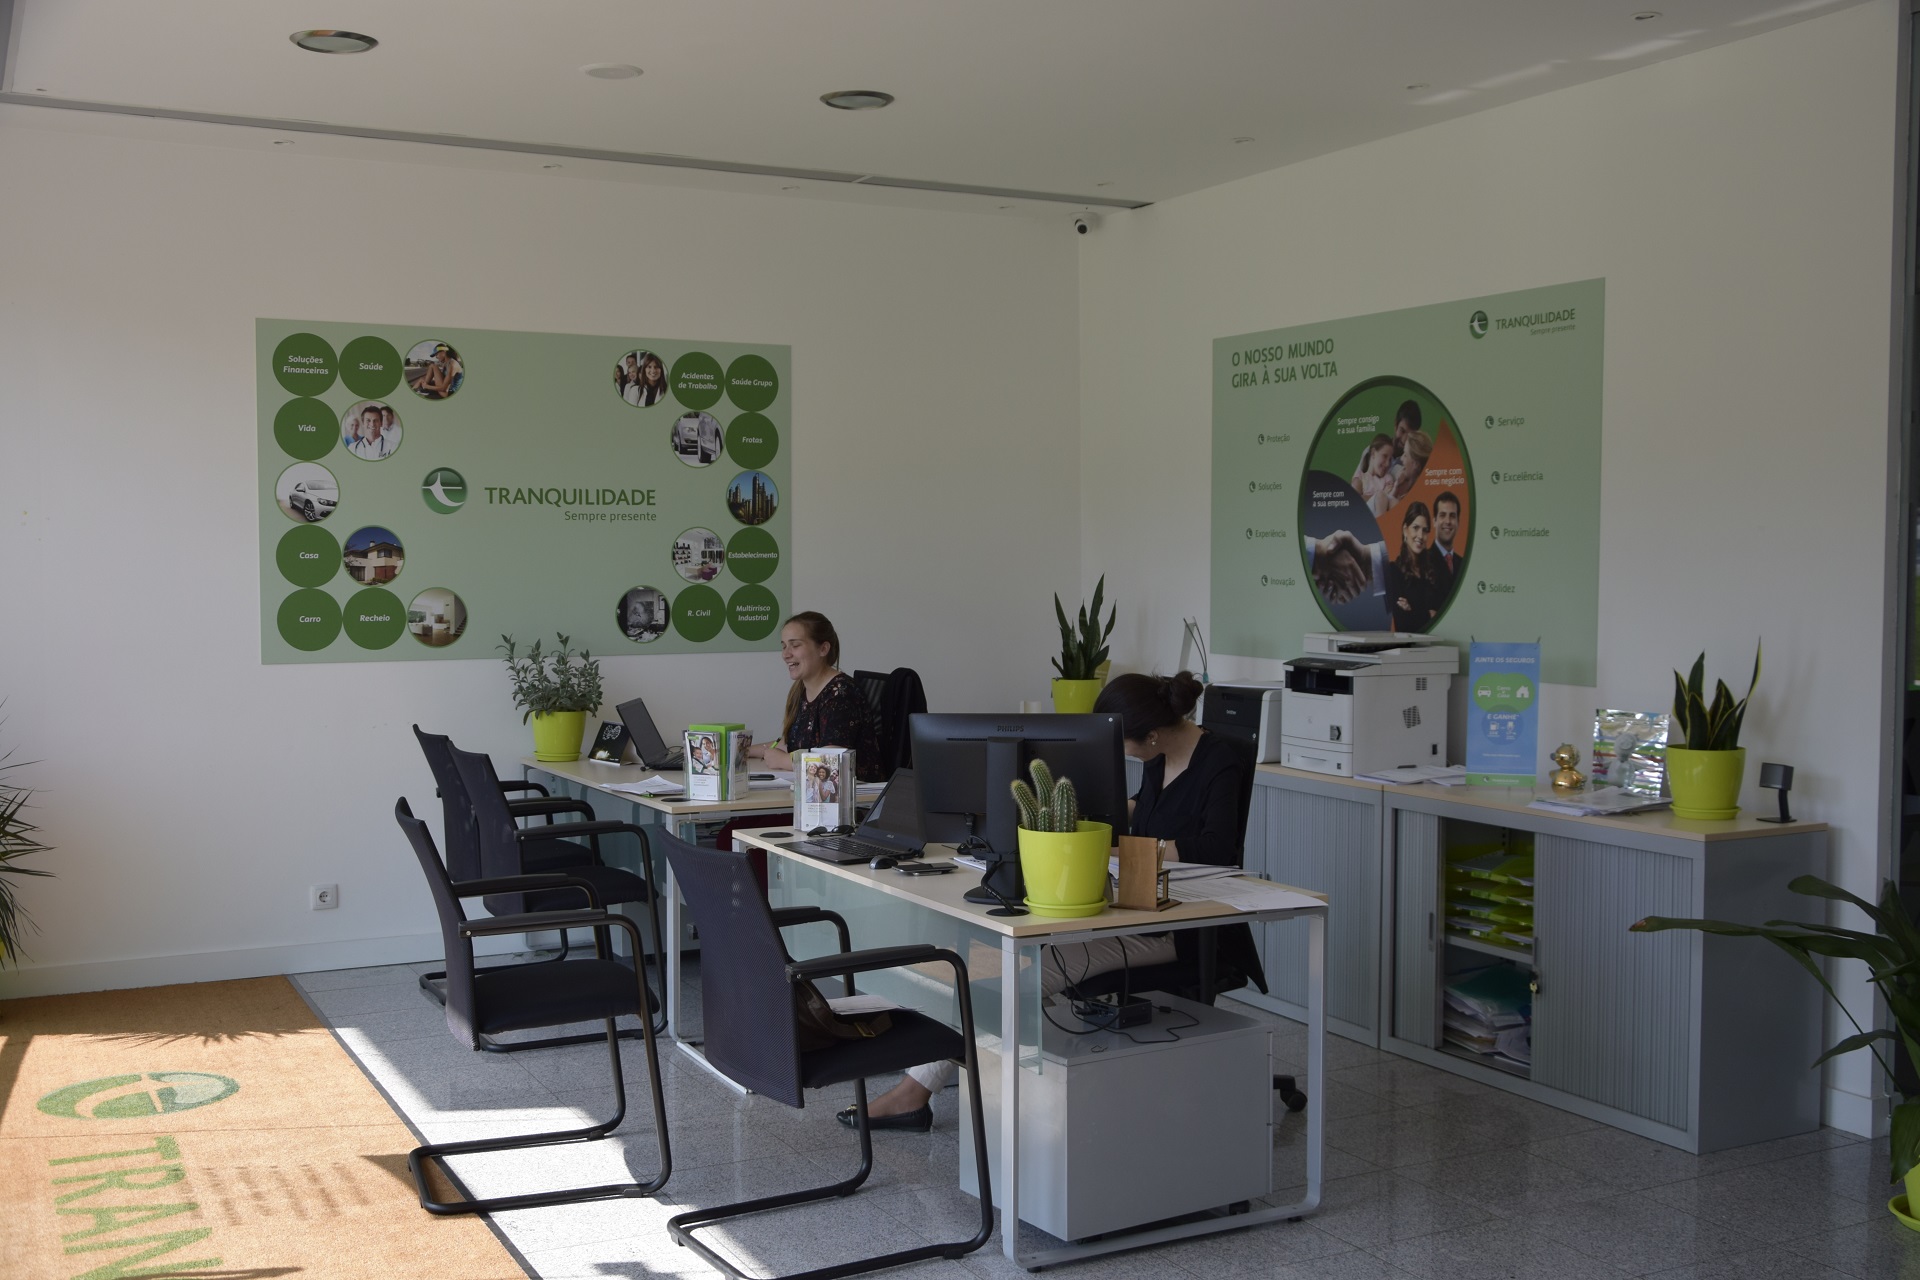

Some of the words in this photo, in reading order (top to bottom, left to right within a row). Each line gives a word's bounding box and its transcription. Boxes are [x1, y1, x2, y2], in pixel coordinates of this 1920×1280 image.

[1495, 308, 1576, 330] TRANQUILIDADE
[1530, 327, 1551, 336] Sempre
[1551, 324, 1576, 334] presente
[1232, 352, 1240, 366] O
[1245, 346, 1283, 365] NOSSO
[1288, 338, 1334, 359] MUNDO
[288, 355, 324, 364] Soluções
[283, 366, 329, 375] Financeiras
[359, 362, 383, 371] Saúde
[681, 372, 714, 380] Acidentes
[1232, 372, 1258, 388] GIRA
[1262, 365, 1270, 385] À
[1274, 366, 1297, 383] SUA
[1300, 361, 1338, 380] VOLTA
[688, 382, 718, 390] Trabalho
[731, 378, 752, 386] Saúde
[753, 379, 773, 388] Grupo
[1337, 416, 1358, 426] Sempre
[1358, 415, 1380, 424] consigo
[1497, 417, 1525, 427] Serviço
[298, 424, 316, 432] Vida
[1356, 425, 1376, 433] família
[742, 436, 763, 444] Frotas
[1266, 434, 1291, 443] Proteção
[1425, 468, 1448, 477] Sempre
[1503, 472, 1544, 482] Excelência
[1441, 476, 1465, 486] negócio
[1258, 482, 1283, 491] Soluções
[484, 487, 657, 507] TRANQUILIDADE
[1312, 491, 1332, 499] Sempre
[1327, 500, 1350, 508] empresa
[564, 511, 607, 523] Sempre
[610, 512, 657, 523] presente
[1255, 530, 1287, 539] Experiência
[1503, 528, 1550, 537] Proximidade
[1270, 577, 1295, 587] Inovação
[1489, 584, 1516, 593] Solidez
[695, 609, 711, 617] Civil
[299, 615, 321, 623] Carro
[359, 614, 390, 622] Recheio
